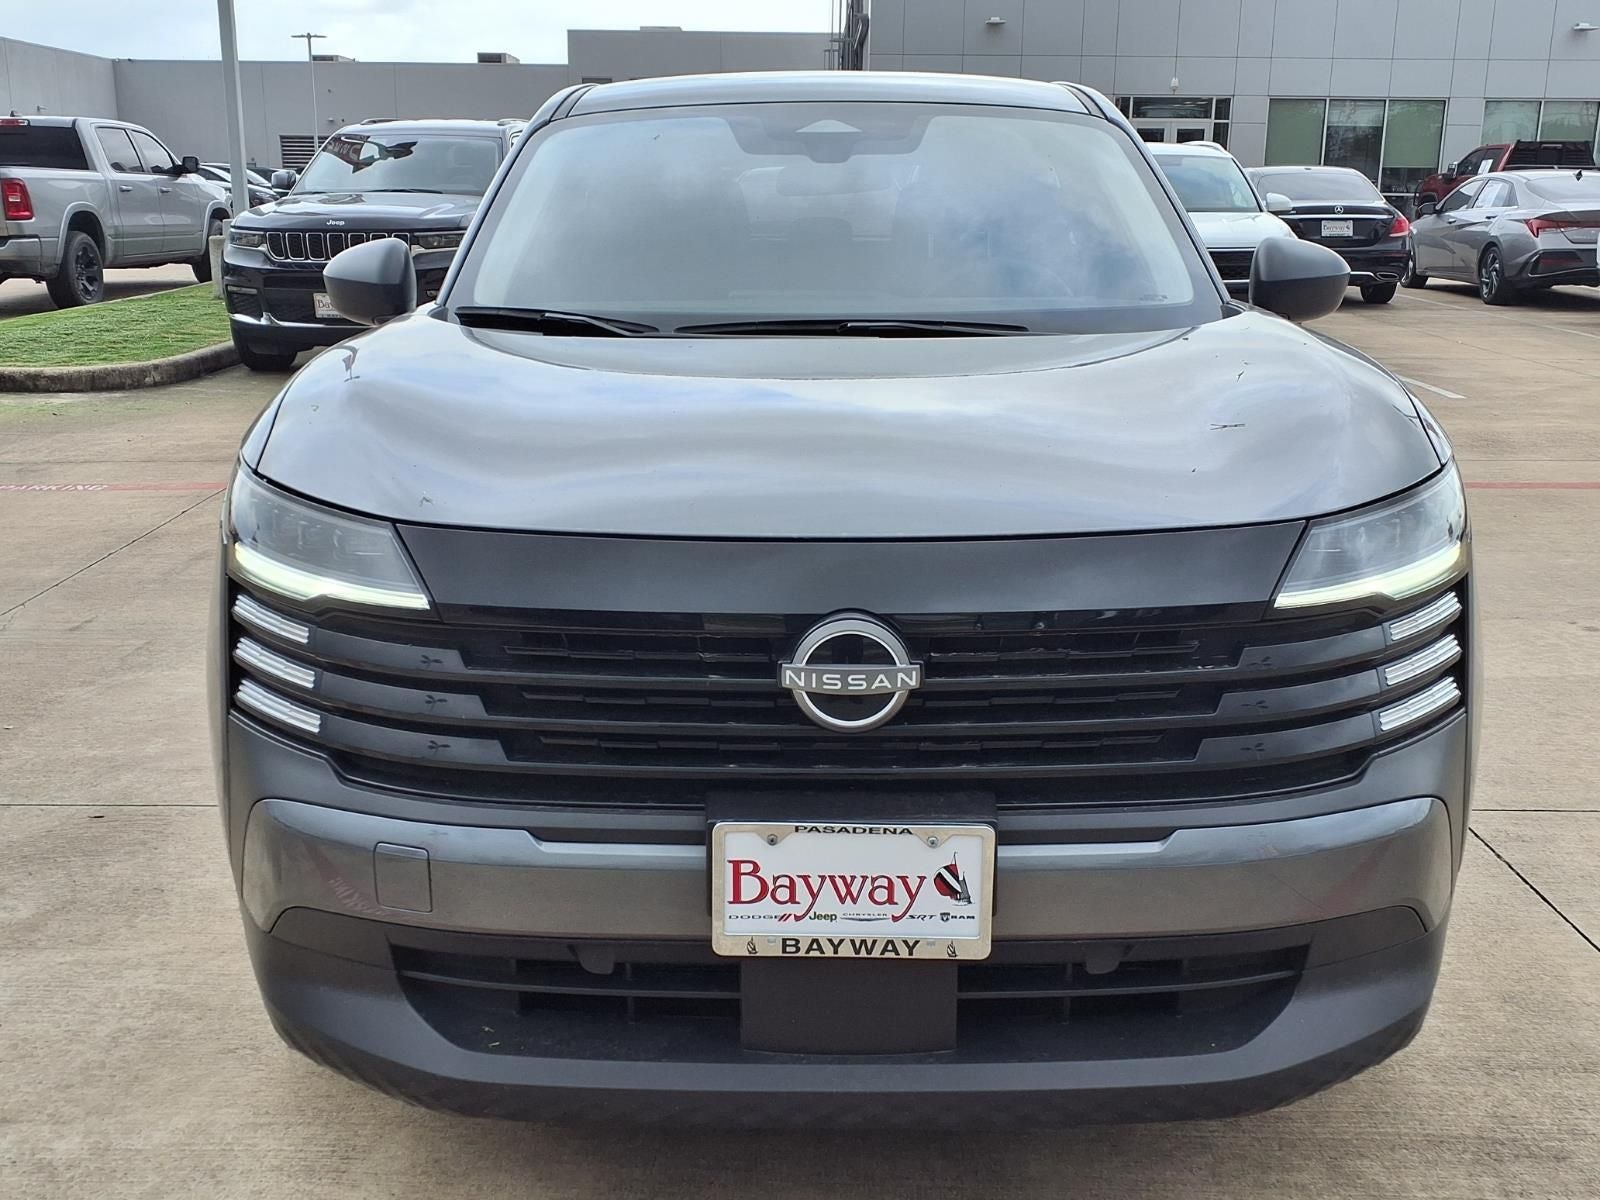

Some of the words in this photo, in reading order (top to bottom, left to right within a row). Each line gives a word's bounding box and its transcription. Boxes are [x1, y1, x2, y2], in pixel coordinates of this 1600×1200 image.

[785, 669, 917, 690] NISSAN
[794, 825, 913, 835] PASADENA
[727, 859, 927, 923] Bayway
[808, 911, 838, 923] Jeep
[781, 938, 921, 956] BAYWAY
